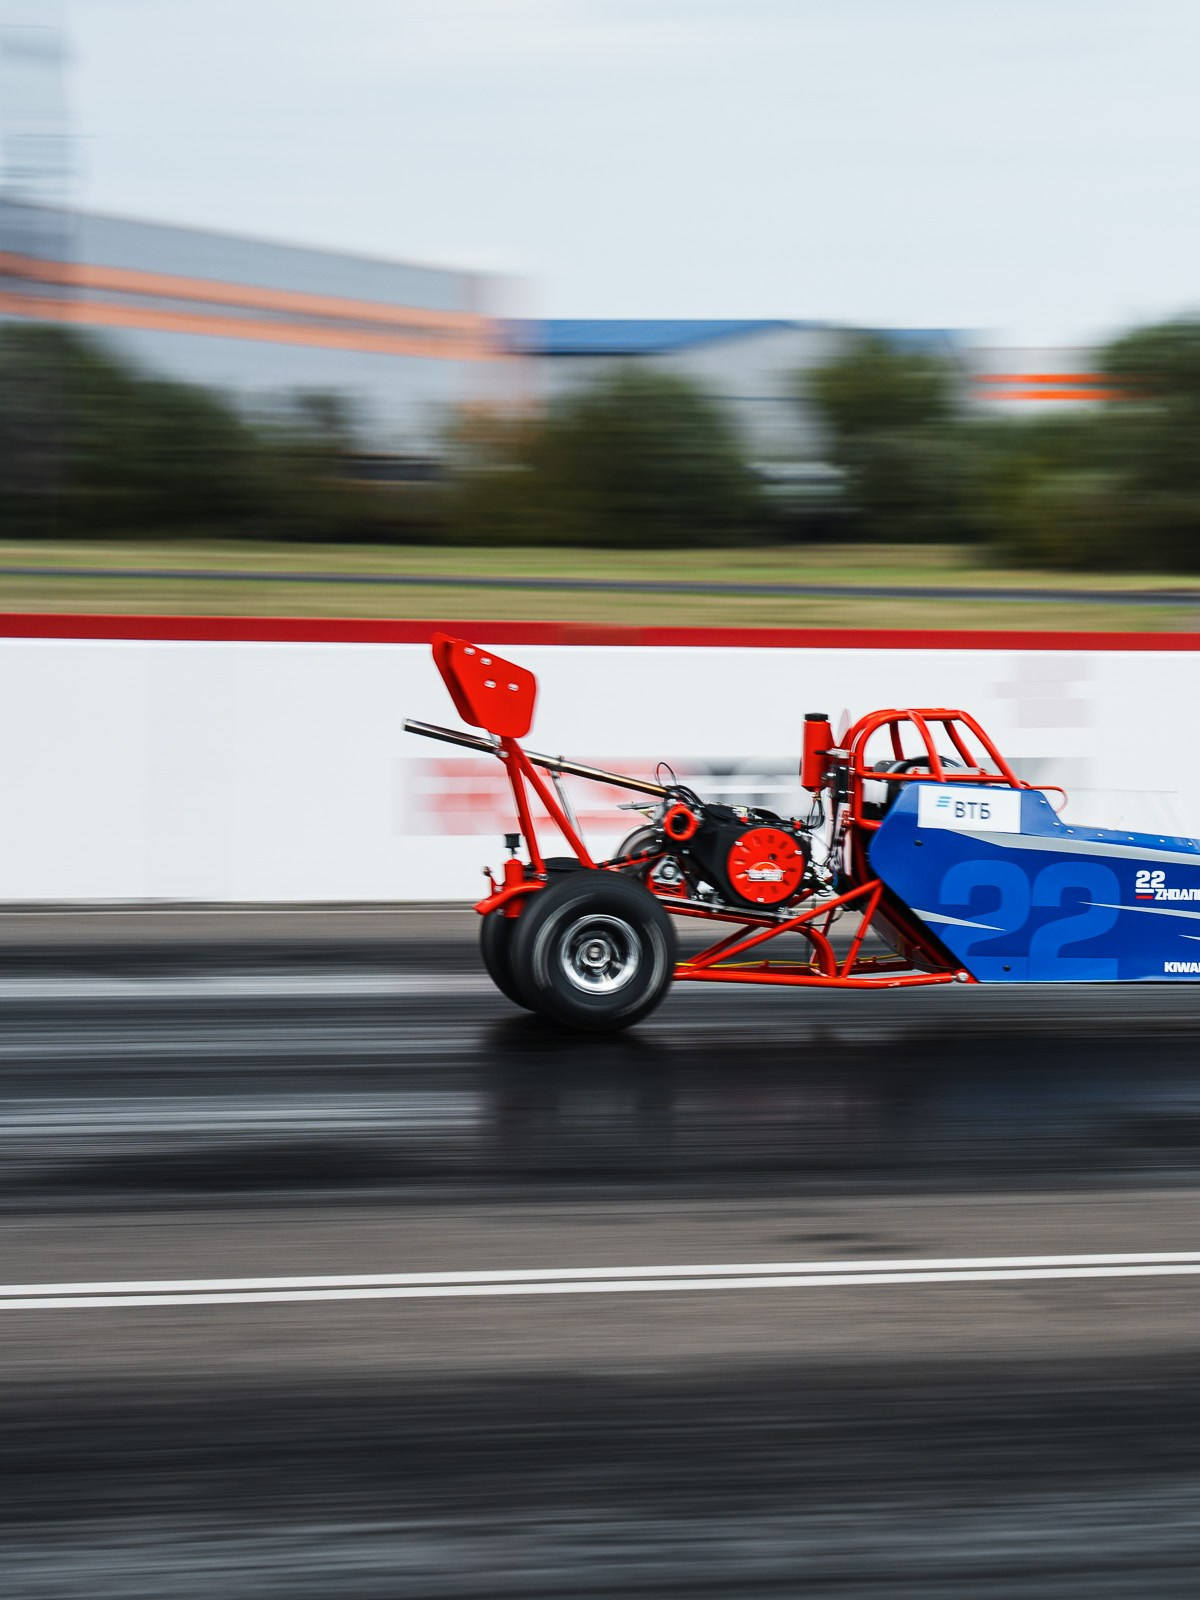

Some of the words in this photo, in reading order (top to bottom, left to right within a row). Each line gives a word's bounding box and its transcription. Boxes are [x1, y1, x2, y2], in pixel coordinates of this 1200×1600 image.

[955, 801, 991, 819] ВТБ
[1135, 870, 1166, 888] 22
[938, 859, 1121, 981] 22
